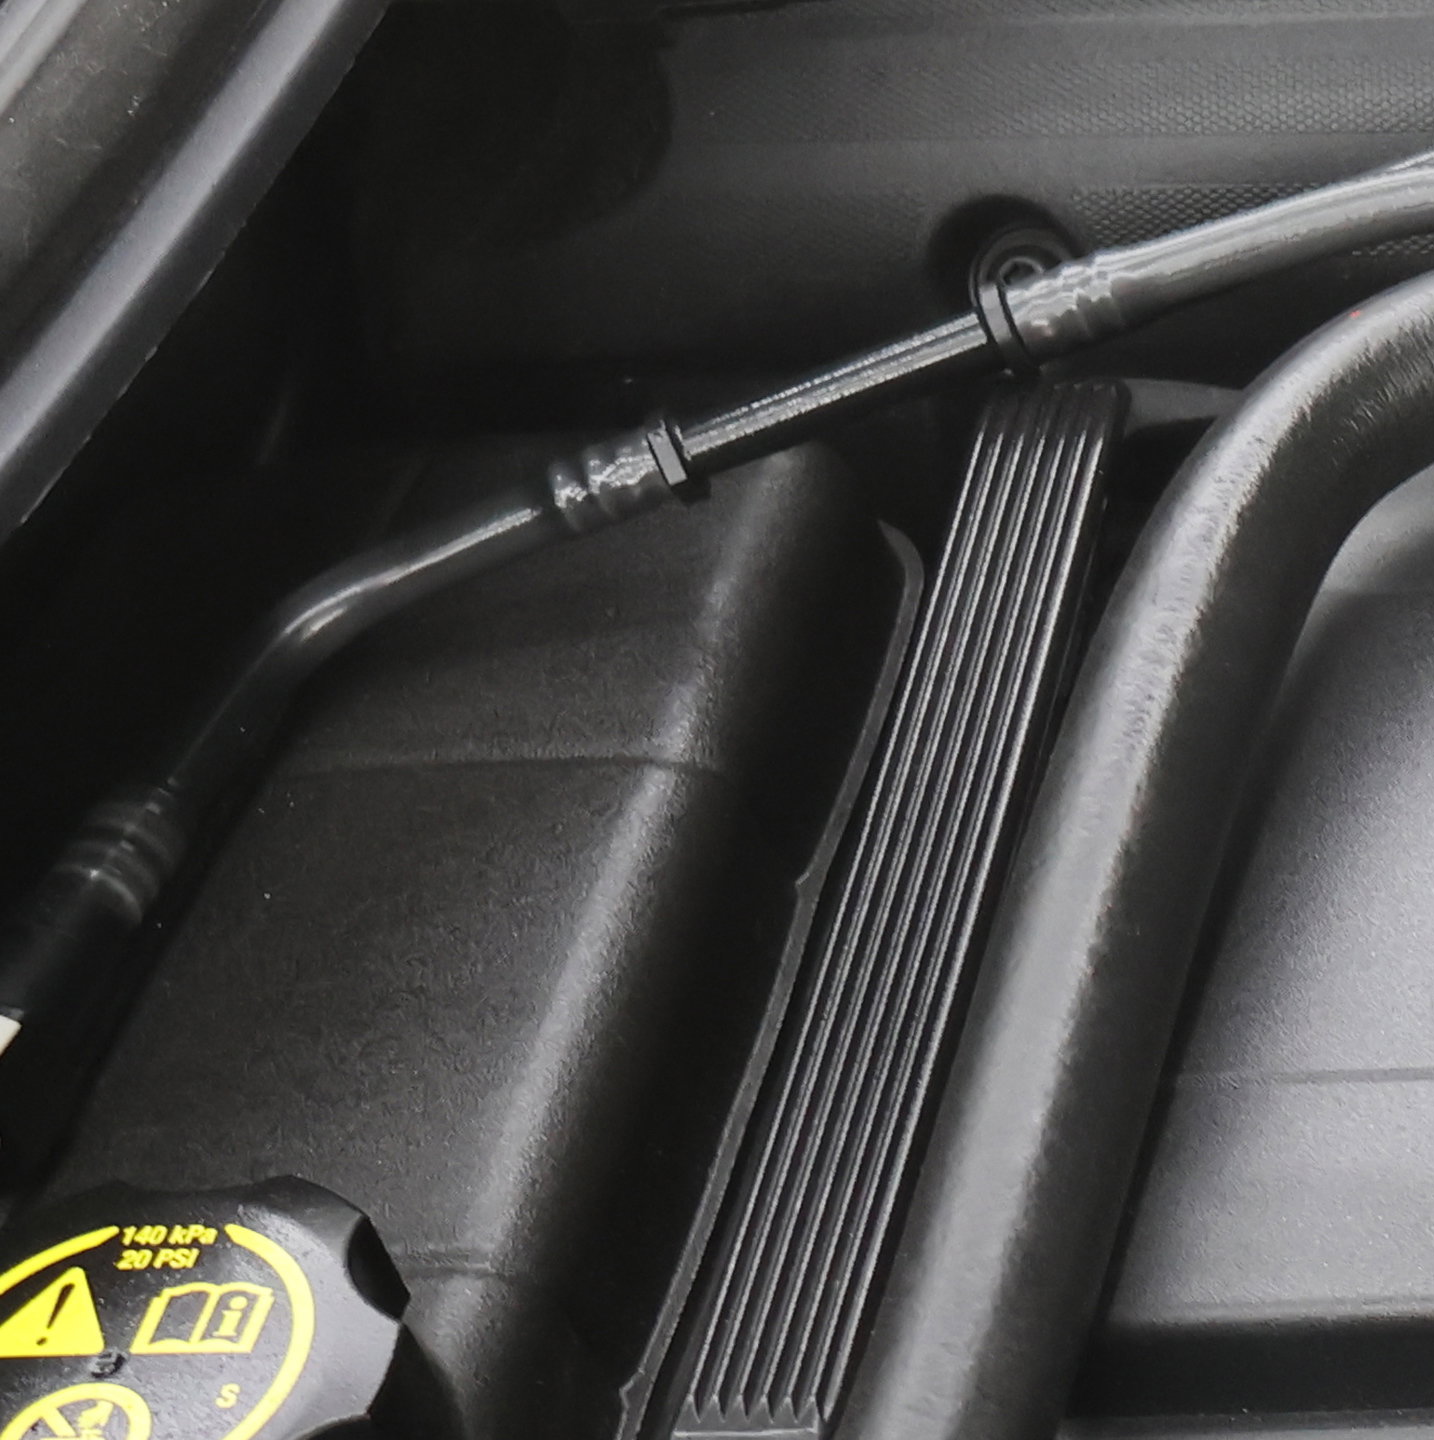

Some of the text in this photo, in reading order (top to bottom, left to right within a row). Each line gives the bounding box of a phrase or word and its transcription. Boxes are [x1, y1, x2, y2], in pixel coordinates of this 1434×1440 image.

[122, 1224, 218, 1246] 140 kPa
[115, 1248, 200, 1270] 20 PSI
[215, 1384, 240, 1408] S
